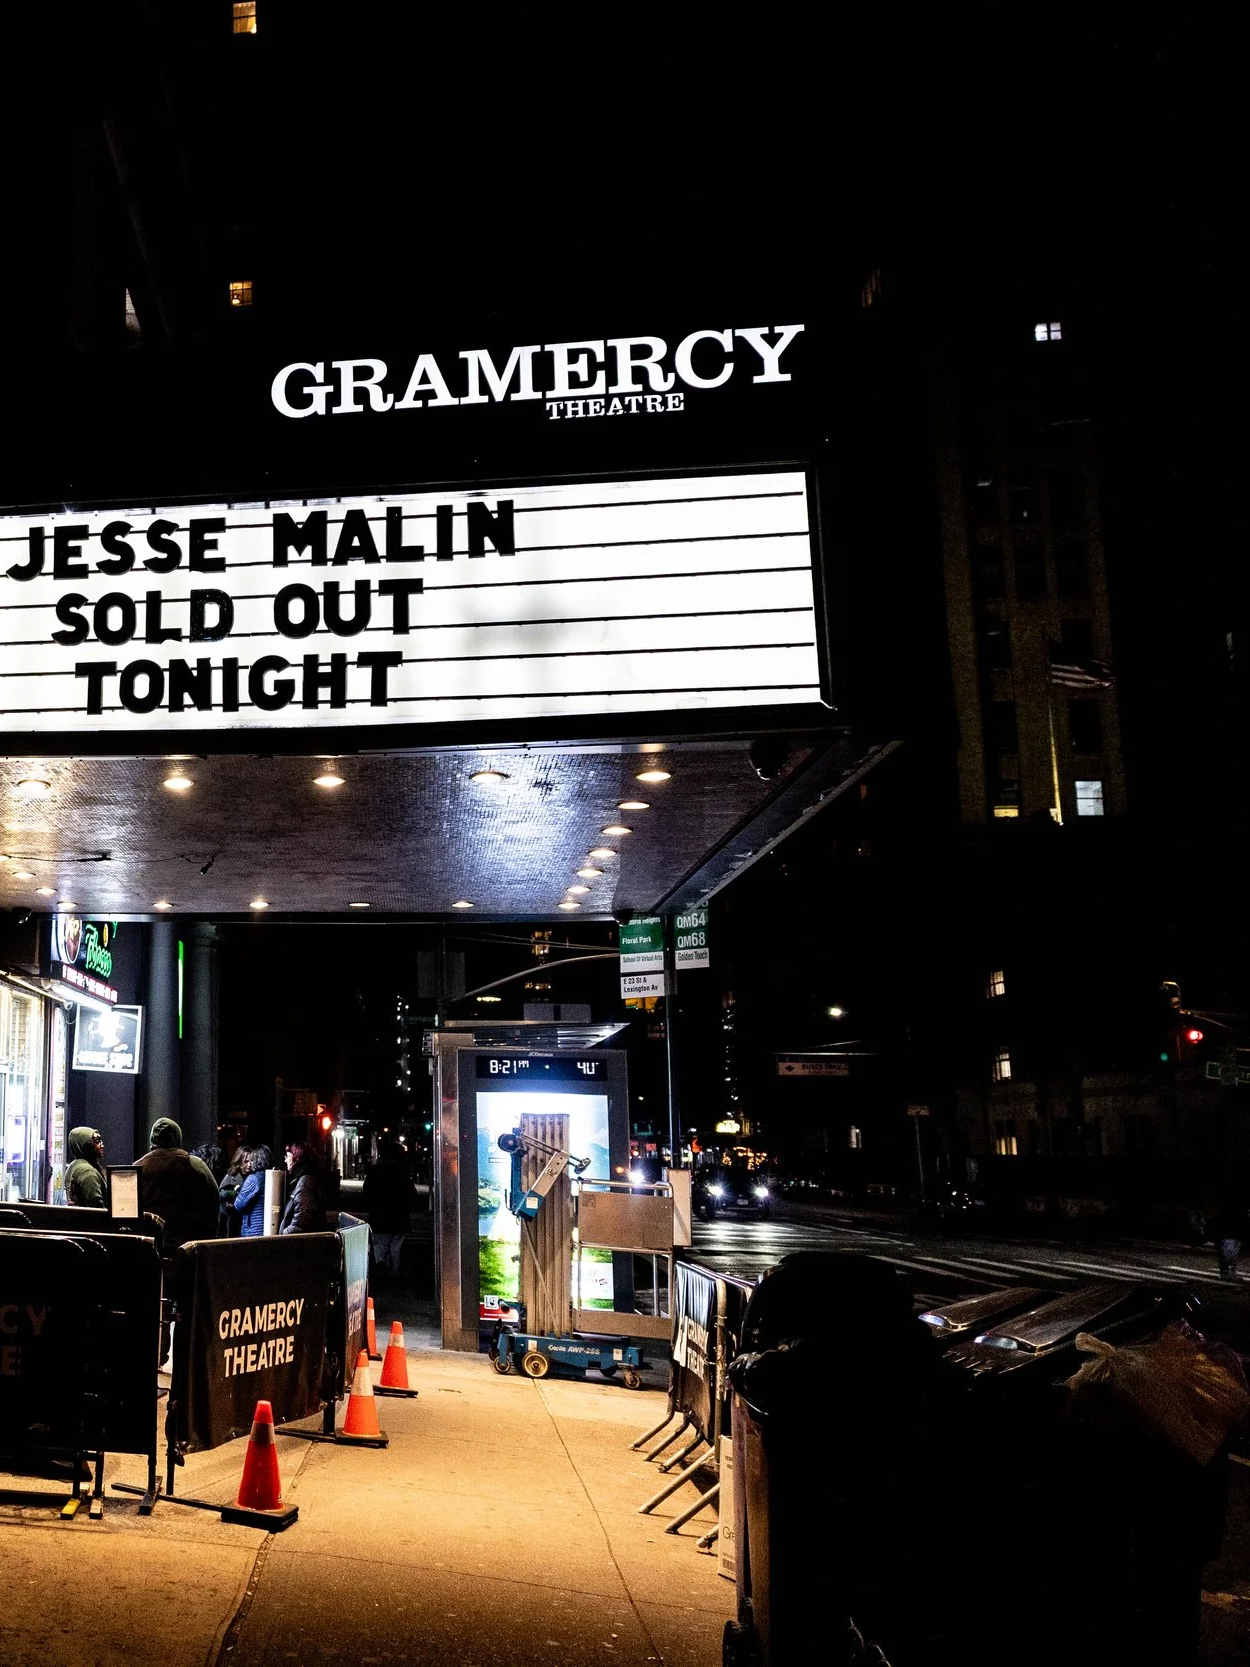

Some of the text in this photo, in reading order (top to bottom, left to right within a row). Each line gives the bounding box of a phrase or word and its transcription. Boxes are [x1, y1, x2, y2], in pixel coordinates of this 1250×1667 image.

[270, 324, 806, 418] GRAMERCY
[545, 392, 685, 420] THEATRE
[5, 500, 516, 582] JESSE MALIN
[51, 578, 424, 646] SOLD OUT
[74, 650, 404, 715] TONIGHT
[676, 912, 706, 929] QM64
[622, 935, 652, 945] Floral Park
[677, 931, 706, 948] QM68
[622, 955, 635, 963] School
[677, 952, 693, 962] Golden
[643, 976, 647, 984] &
[623, 985, 650, 994] Lexington
[219, 1298, 305, 1340] GRAMERCY
[224, 1335, 295, 1378] THEATRE
[548, 1344, 566, 1352] Genie
